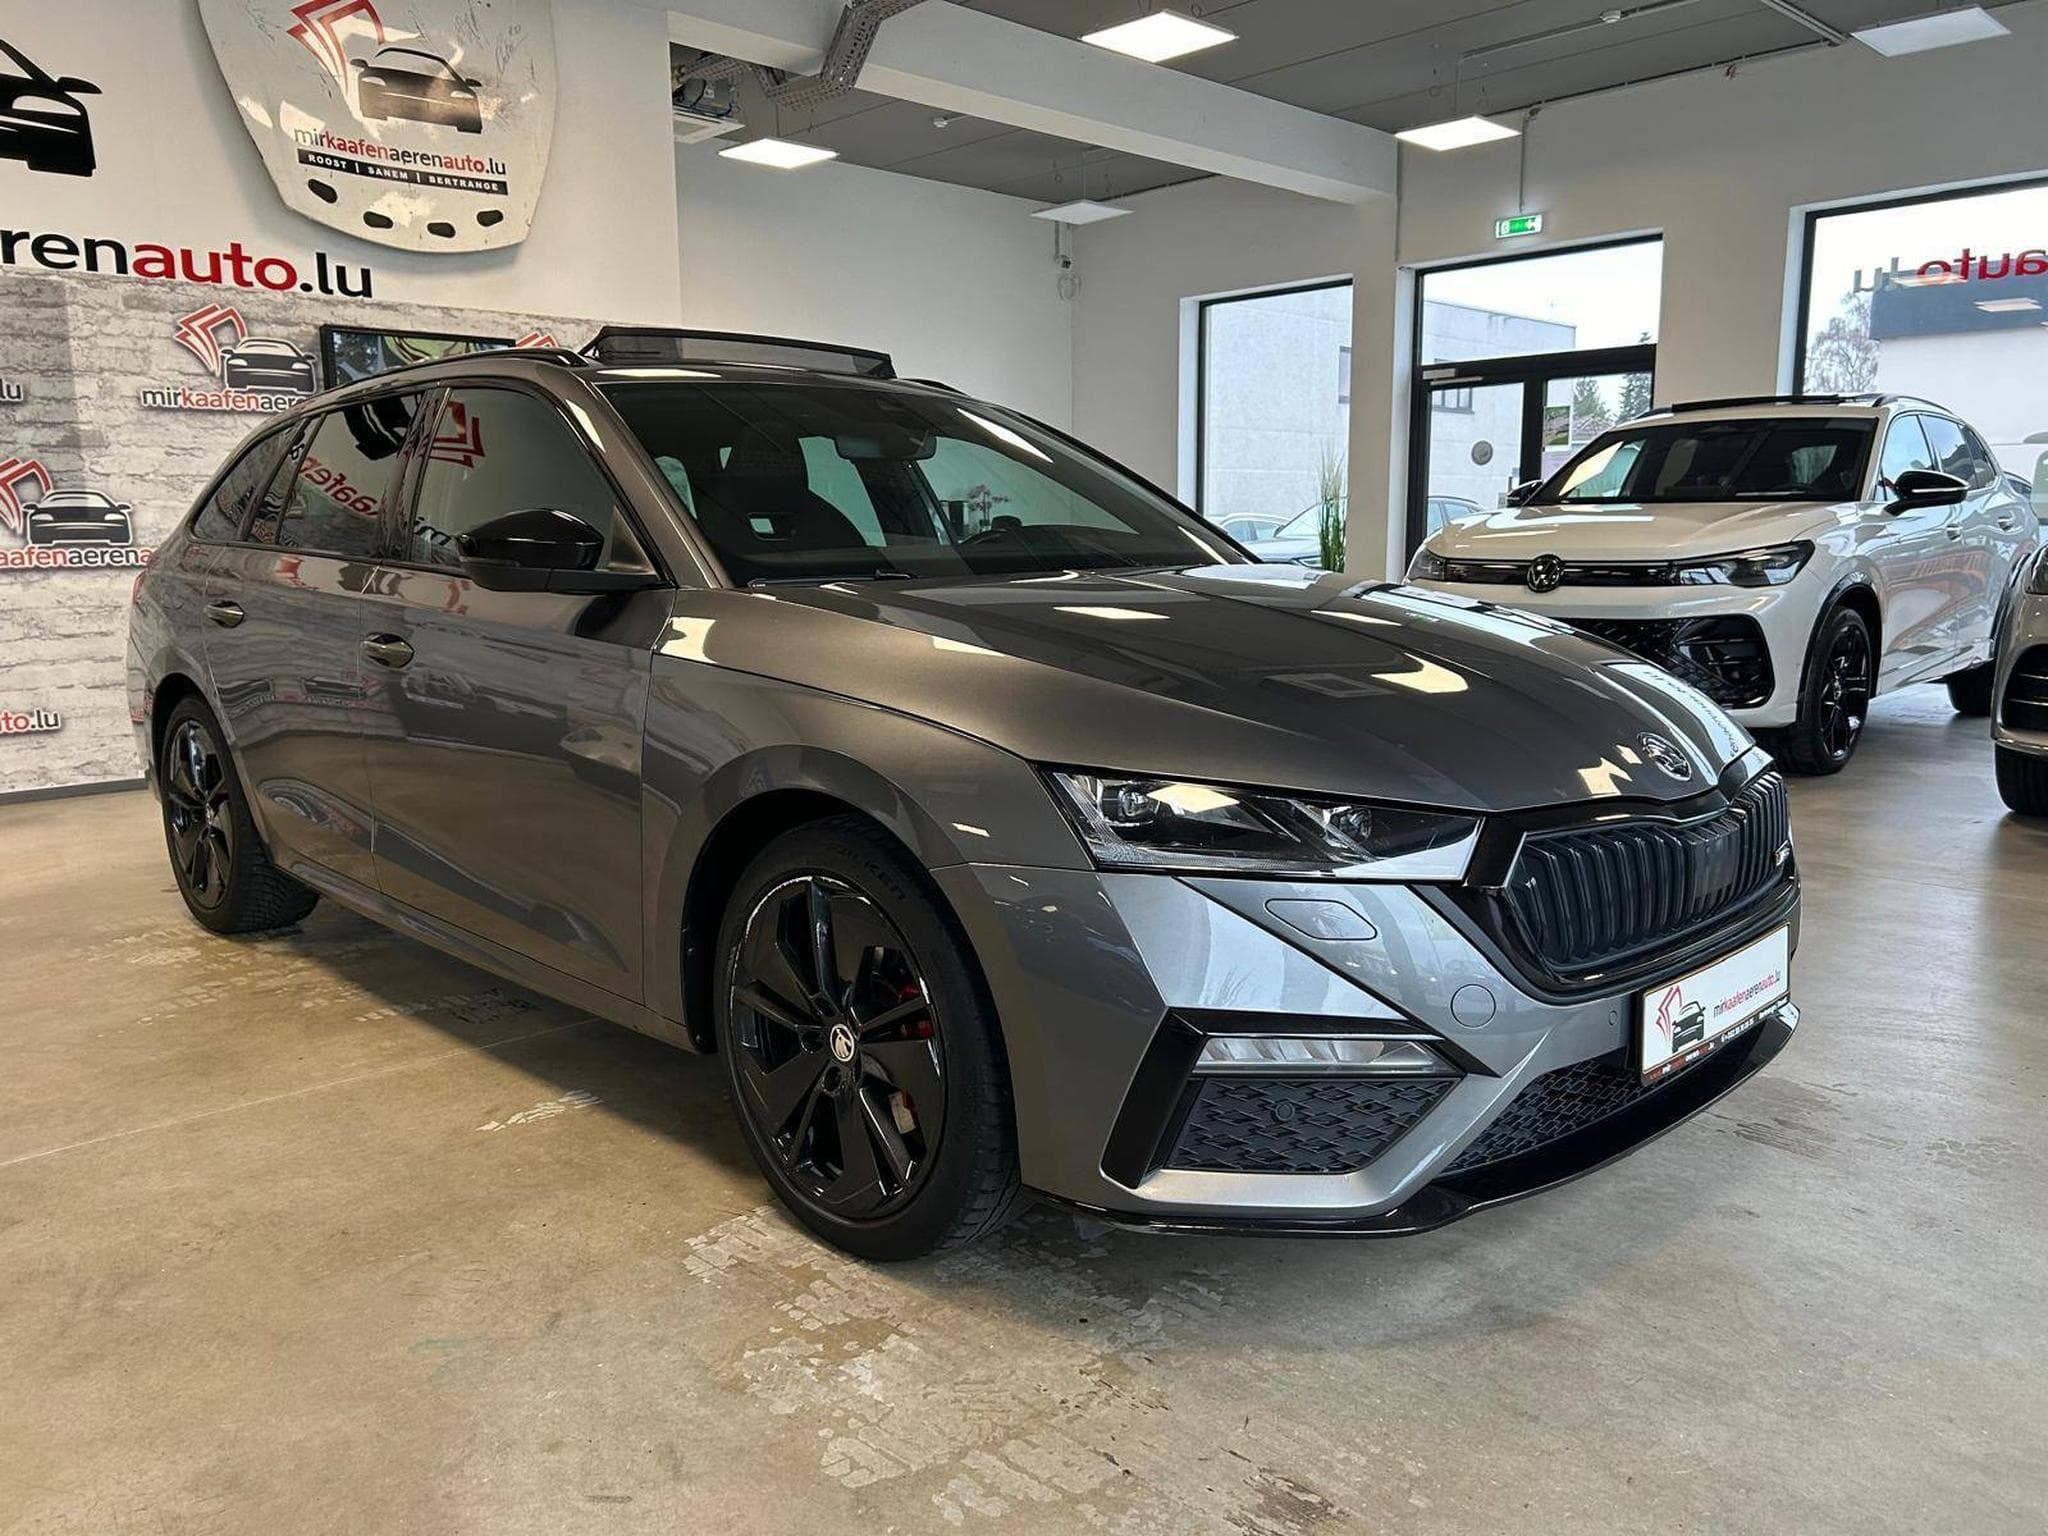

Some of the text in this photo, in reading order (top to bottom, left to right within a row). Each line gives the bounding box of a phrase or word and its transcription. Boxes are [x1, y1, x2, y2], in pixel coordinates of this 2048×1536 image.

[294, 128, 506, 176] mirkaafenaerenauto.lu
[308, 153, 499, 192] ROOST SANEM BERTRANGE
